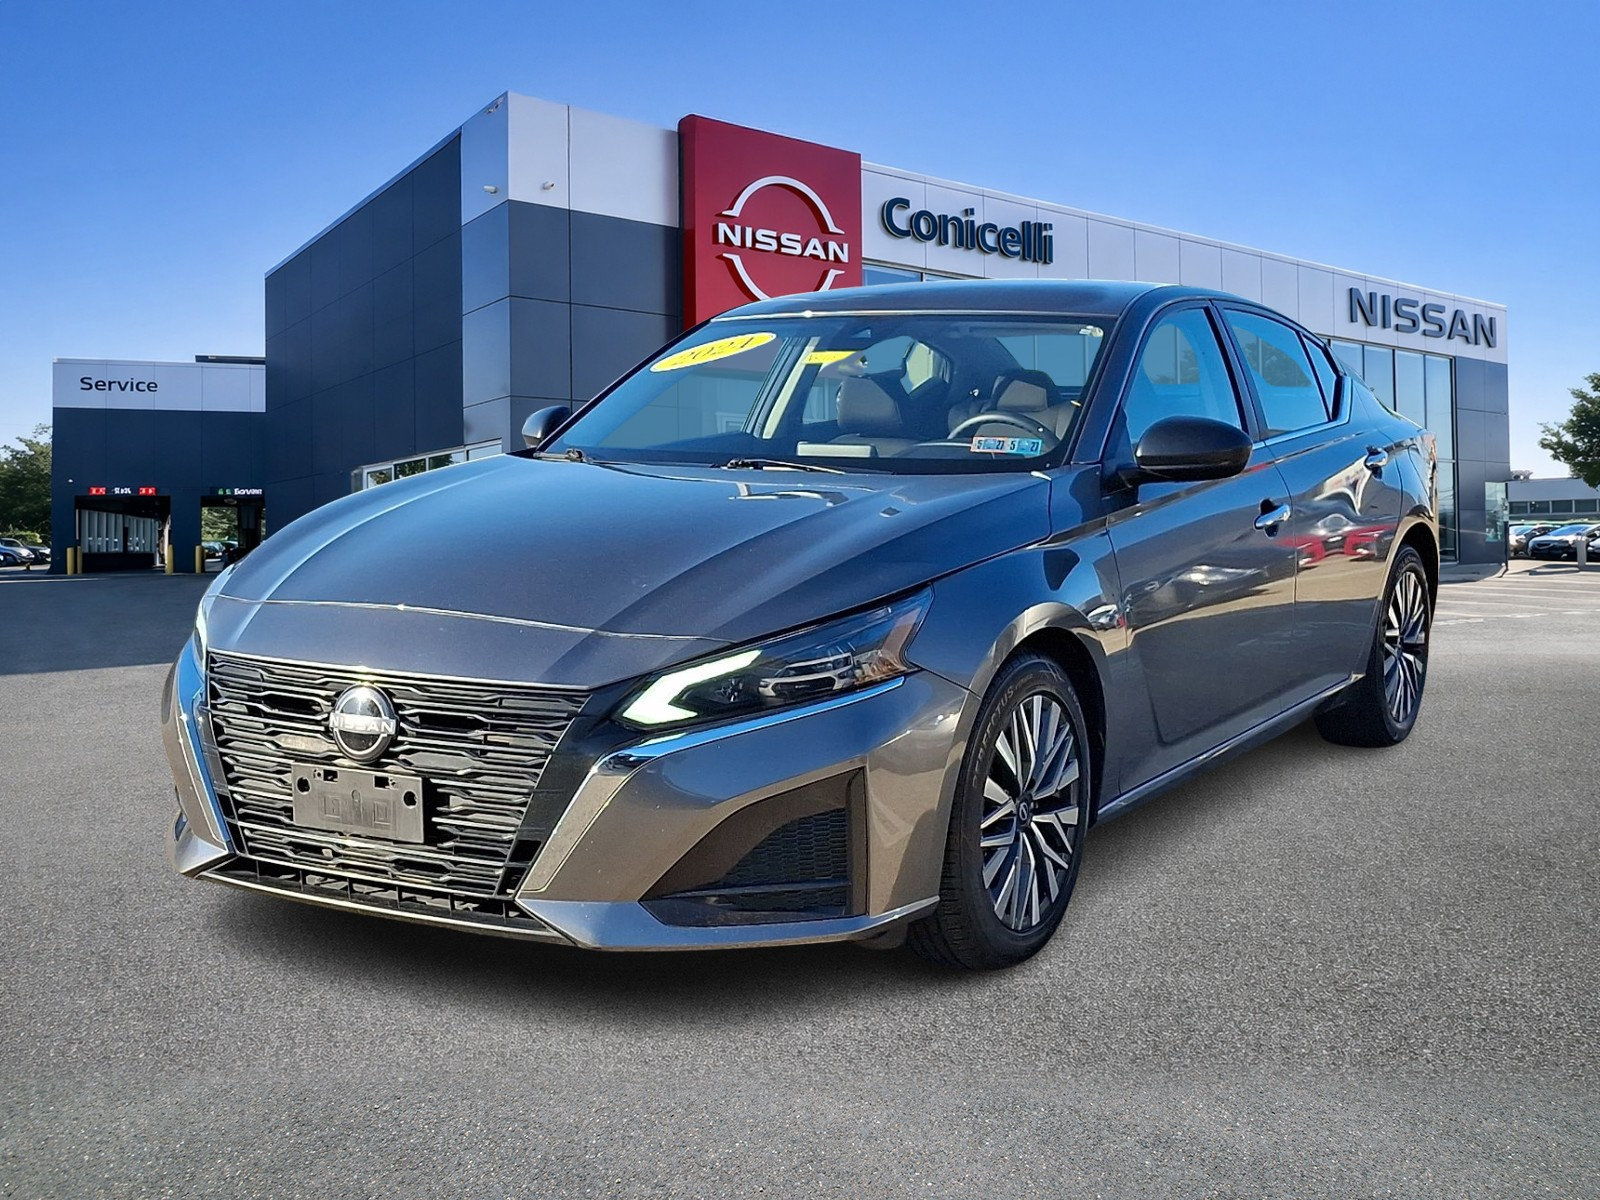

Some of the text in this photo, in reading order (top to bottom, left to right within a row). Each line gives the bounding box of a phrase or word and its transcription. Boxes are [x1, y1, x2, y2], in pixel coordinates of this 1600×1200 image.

[717, 222, 849, 263] NISSAN
[881, 197, 1053, 264] Conicelli
[1349, 287, 1497, 348] NISSAN
[79, 376, 158, 392] Service
